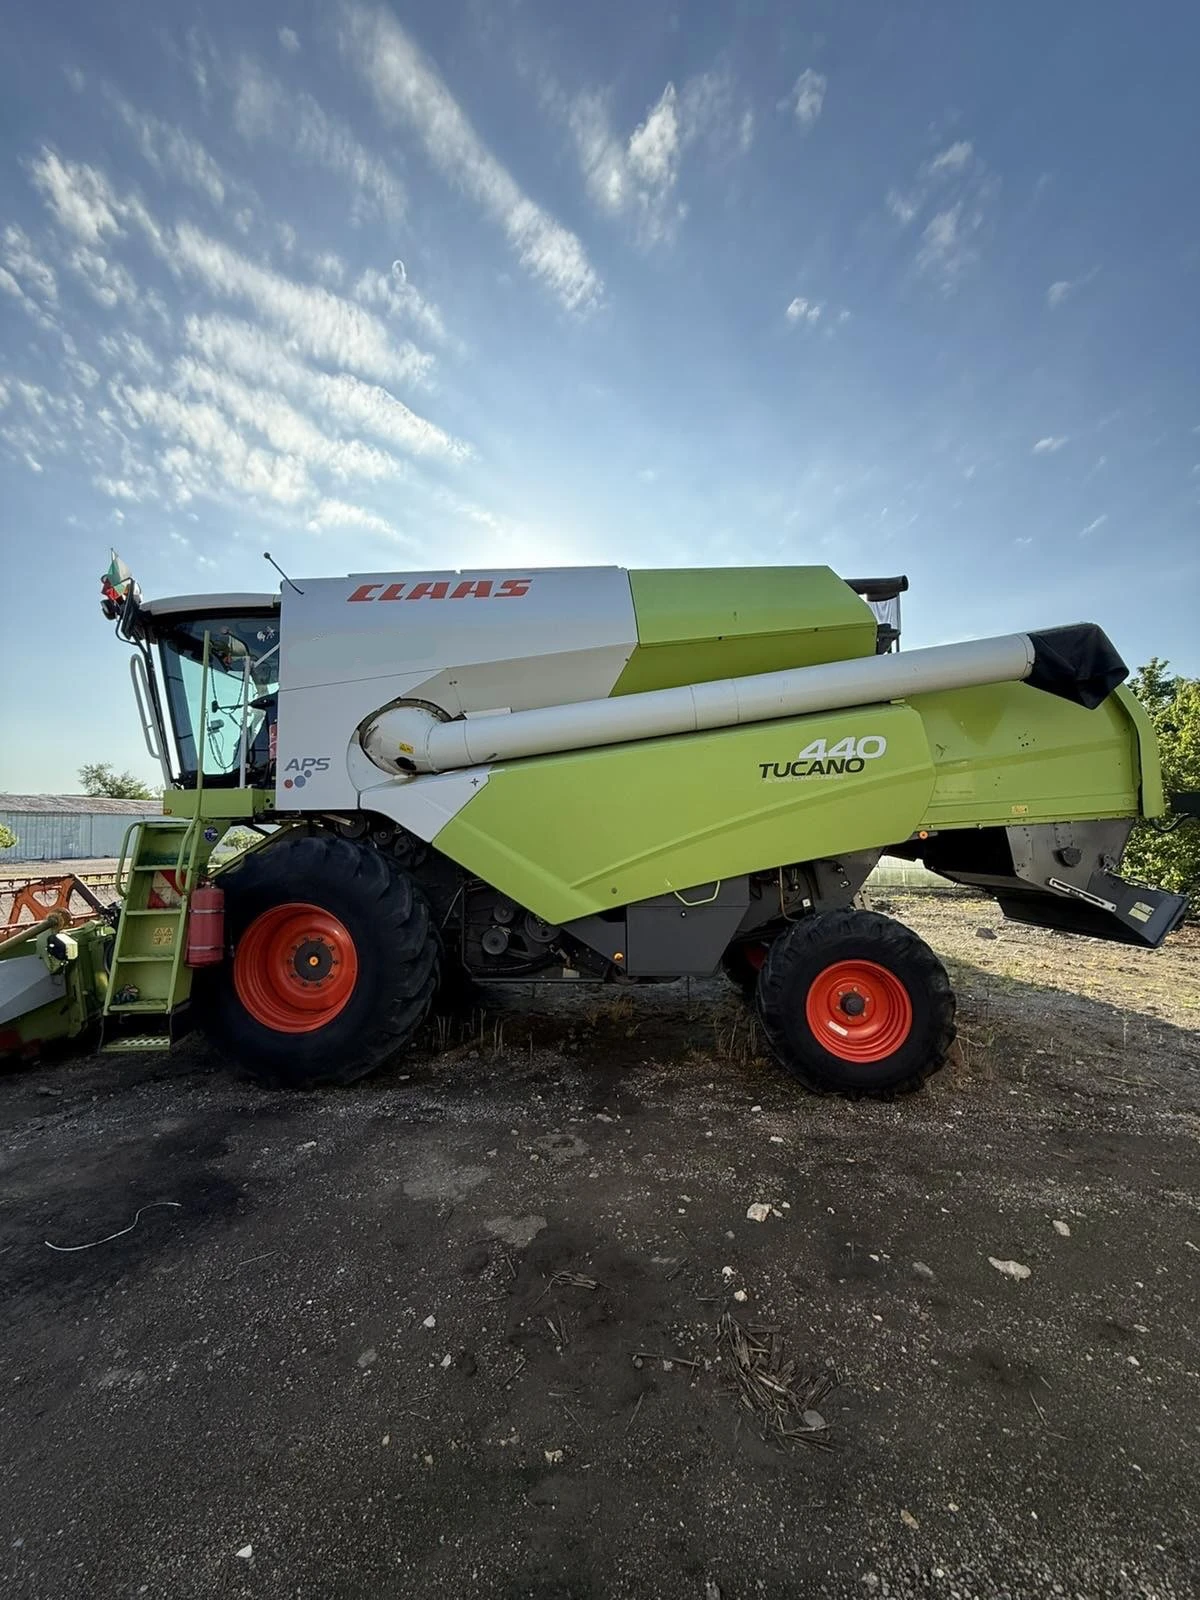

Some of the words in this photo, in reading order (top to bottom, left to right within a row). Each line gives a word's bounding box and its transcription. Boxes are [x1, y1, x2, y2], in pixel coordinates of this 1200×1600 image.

[347, 579, 533, 602] CLAAS
[798, 735, 887, 762] 440
[284, 757, 331, 772] APS
[759, 757, 865, 779] TUCANO
